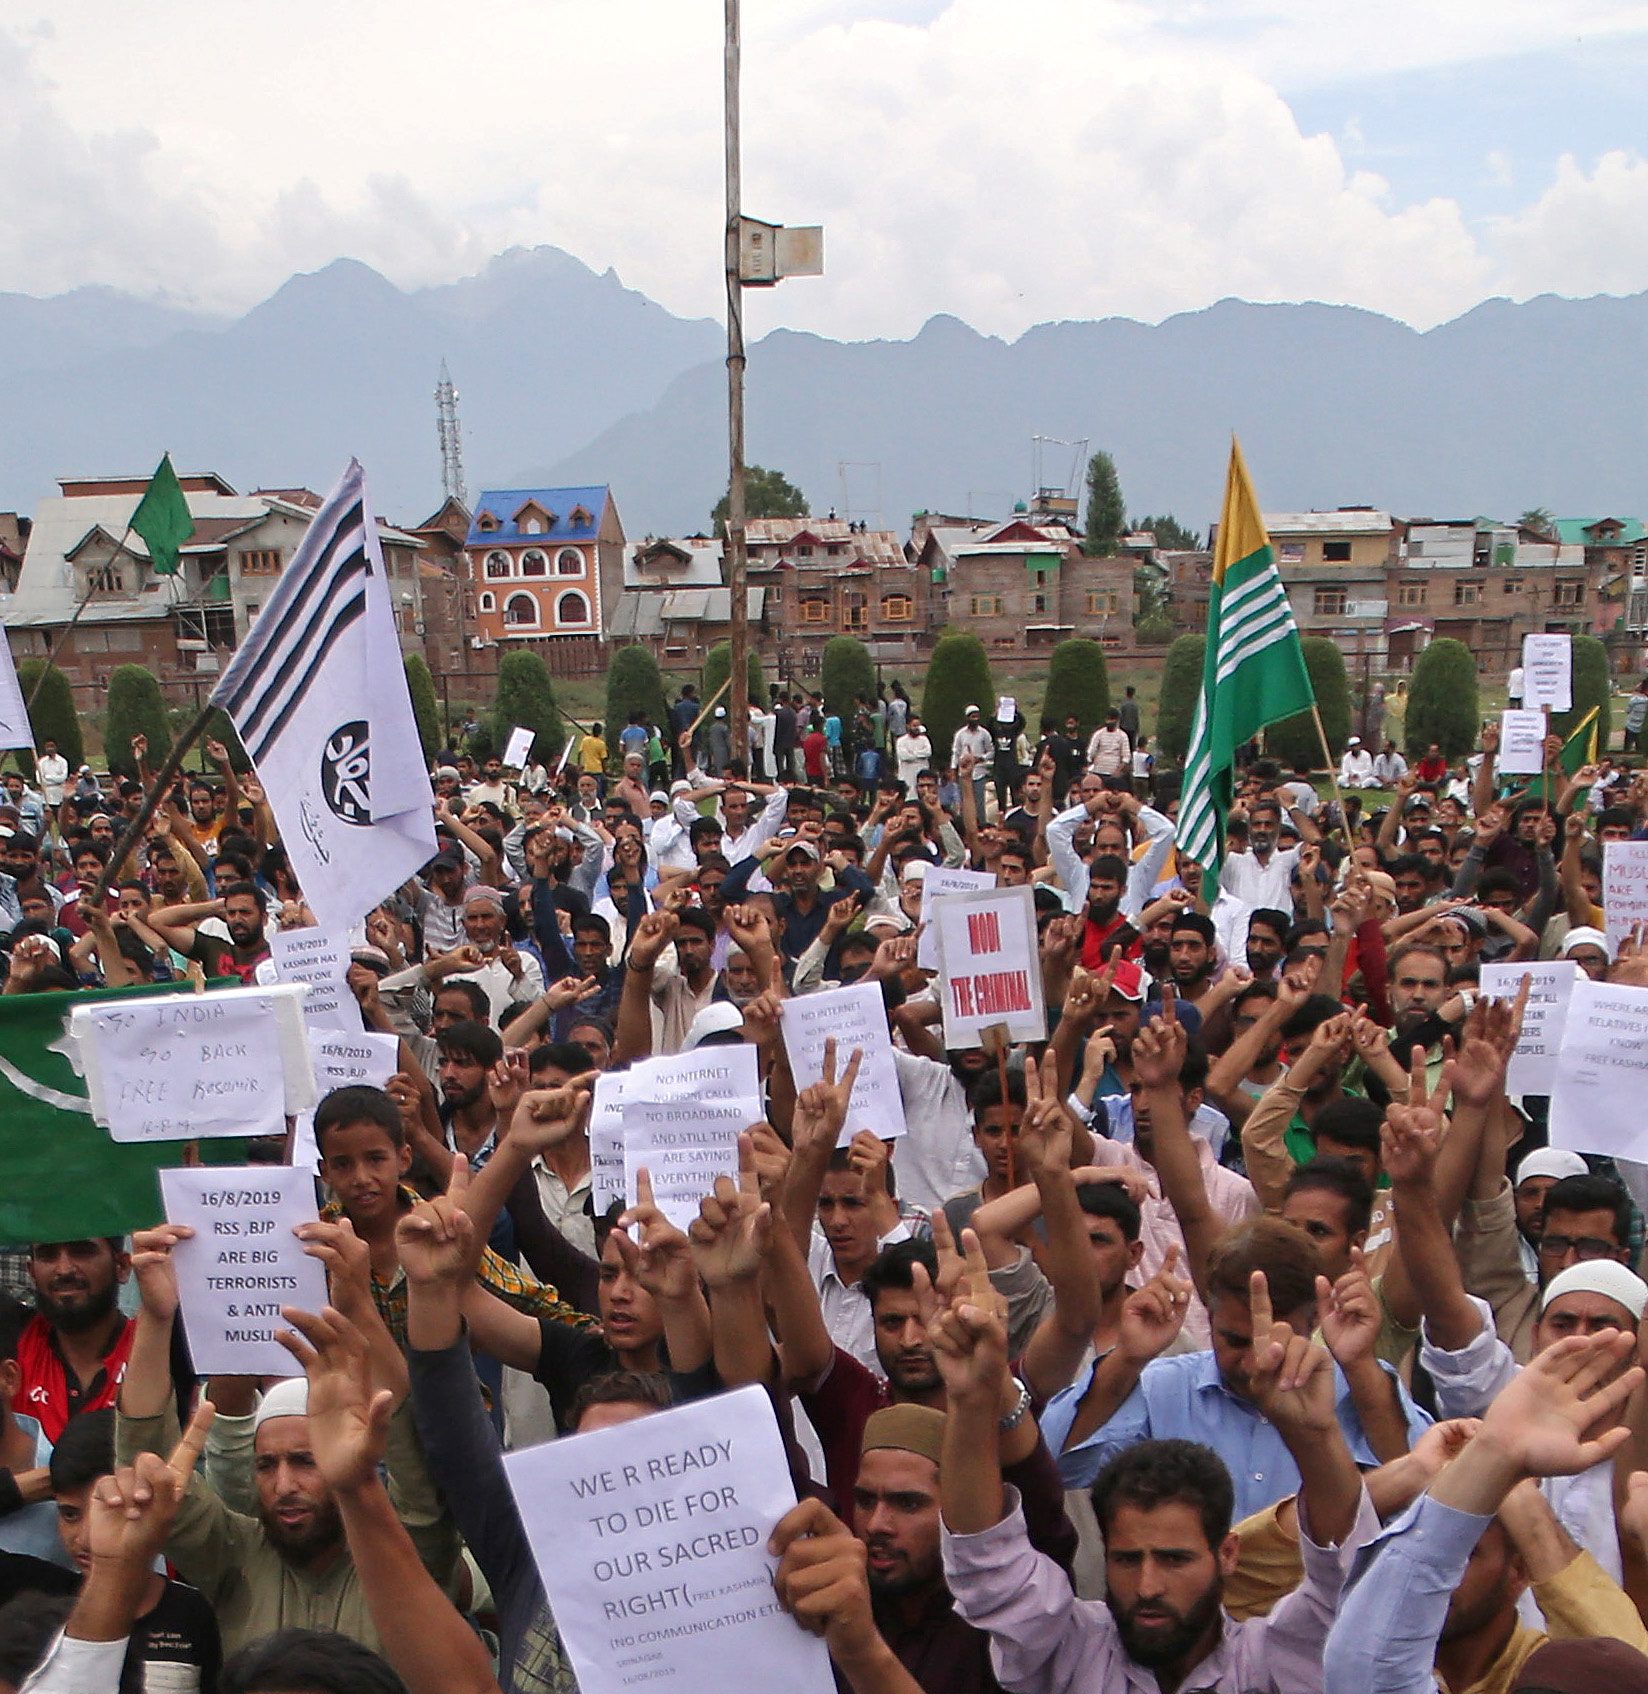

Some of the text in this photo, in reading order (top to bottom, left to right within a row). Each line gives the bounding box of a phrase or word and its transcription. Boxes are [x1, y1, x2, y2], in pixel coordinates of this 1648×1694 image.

[1609, 884, 1633, 895] ARE
[967, 911, 1001, 955] MODI
[283, 954, 338, 969] KASHMIR HAS
[292, 971, 333, 983] ONLY ONE
[950, 970, 1033, 1017] THE CRIMINAL
[156, 1004, 227, 1027] INDIA
[303, 1002, 339, 1015] REEDOM
[202, 1044, 248, 1062] BACK
[321, 1044, 372, 1059] 16/8/2019
[327, 1067, 344, 1077] RSS
[656, 1067, 730, 1085] NO INTERNET
[646, 1108, 742, 1122] NO BROADBAND
[652, 1134, 676, 1144] AND
[680, 1132, 707, 1143] STILL
[663, 1150, 731, 1163] ARE SAYING
[201, 1190, 281, 1208] 16/8/2019
[214, 1221, 240, 1235] RSS
[217, 1250, 278, 1264] ARE BIG
[207, 1276, 297, 1290] TERRORISTS
[227, 1304, 280, 1317] & ANTI
[570, 1440, 734, 1499] WE R READY
[589, 1486, 739, 1538] TO DIE FOR
[593, 1526, 760, 1582] OUR SACRED
[637, 1608, 757, 1643] COMMUNICATION
